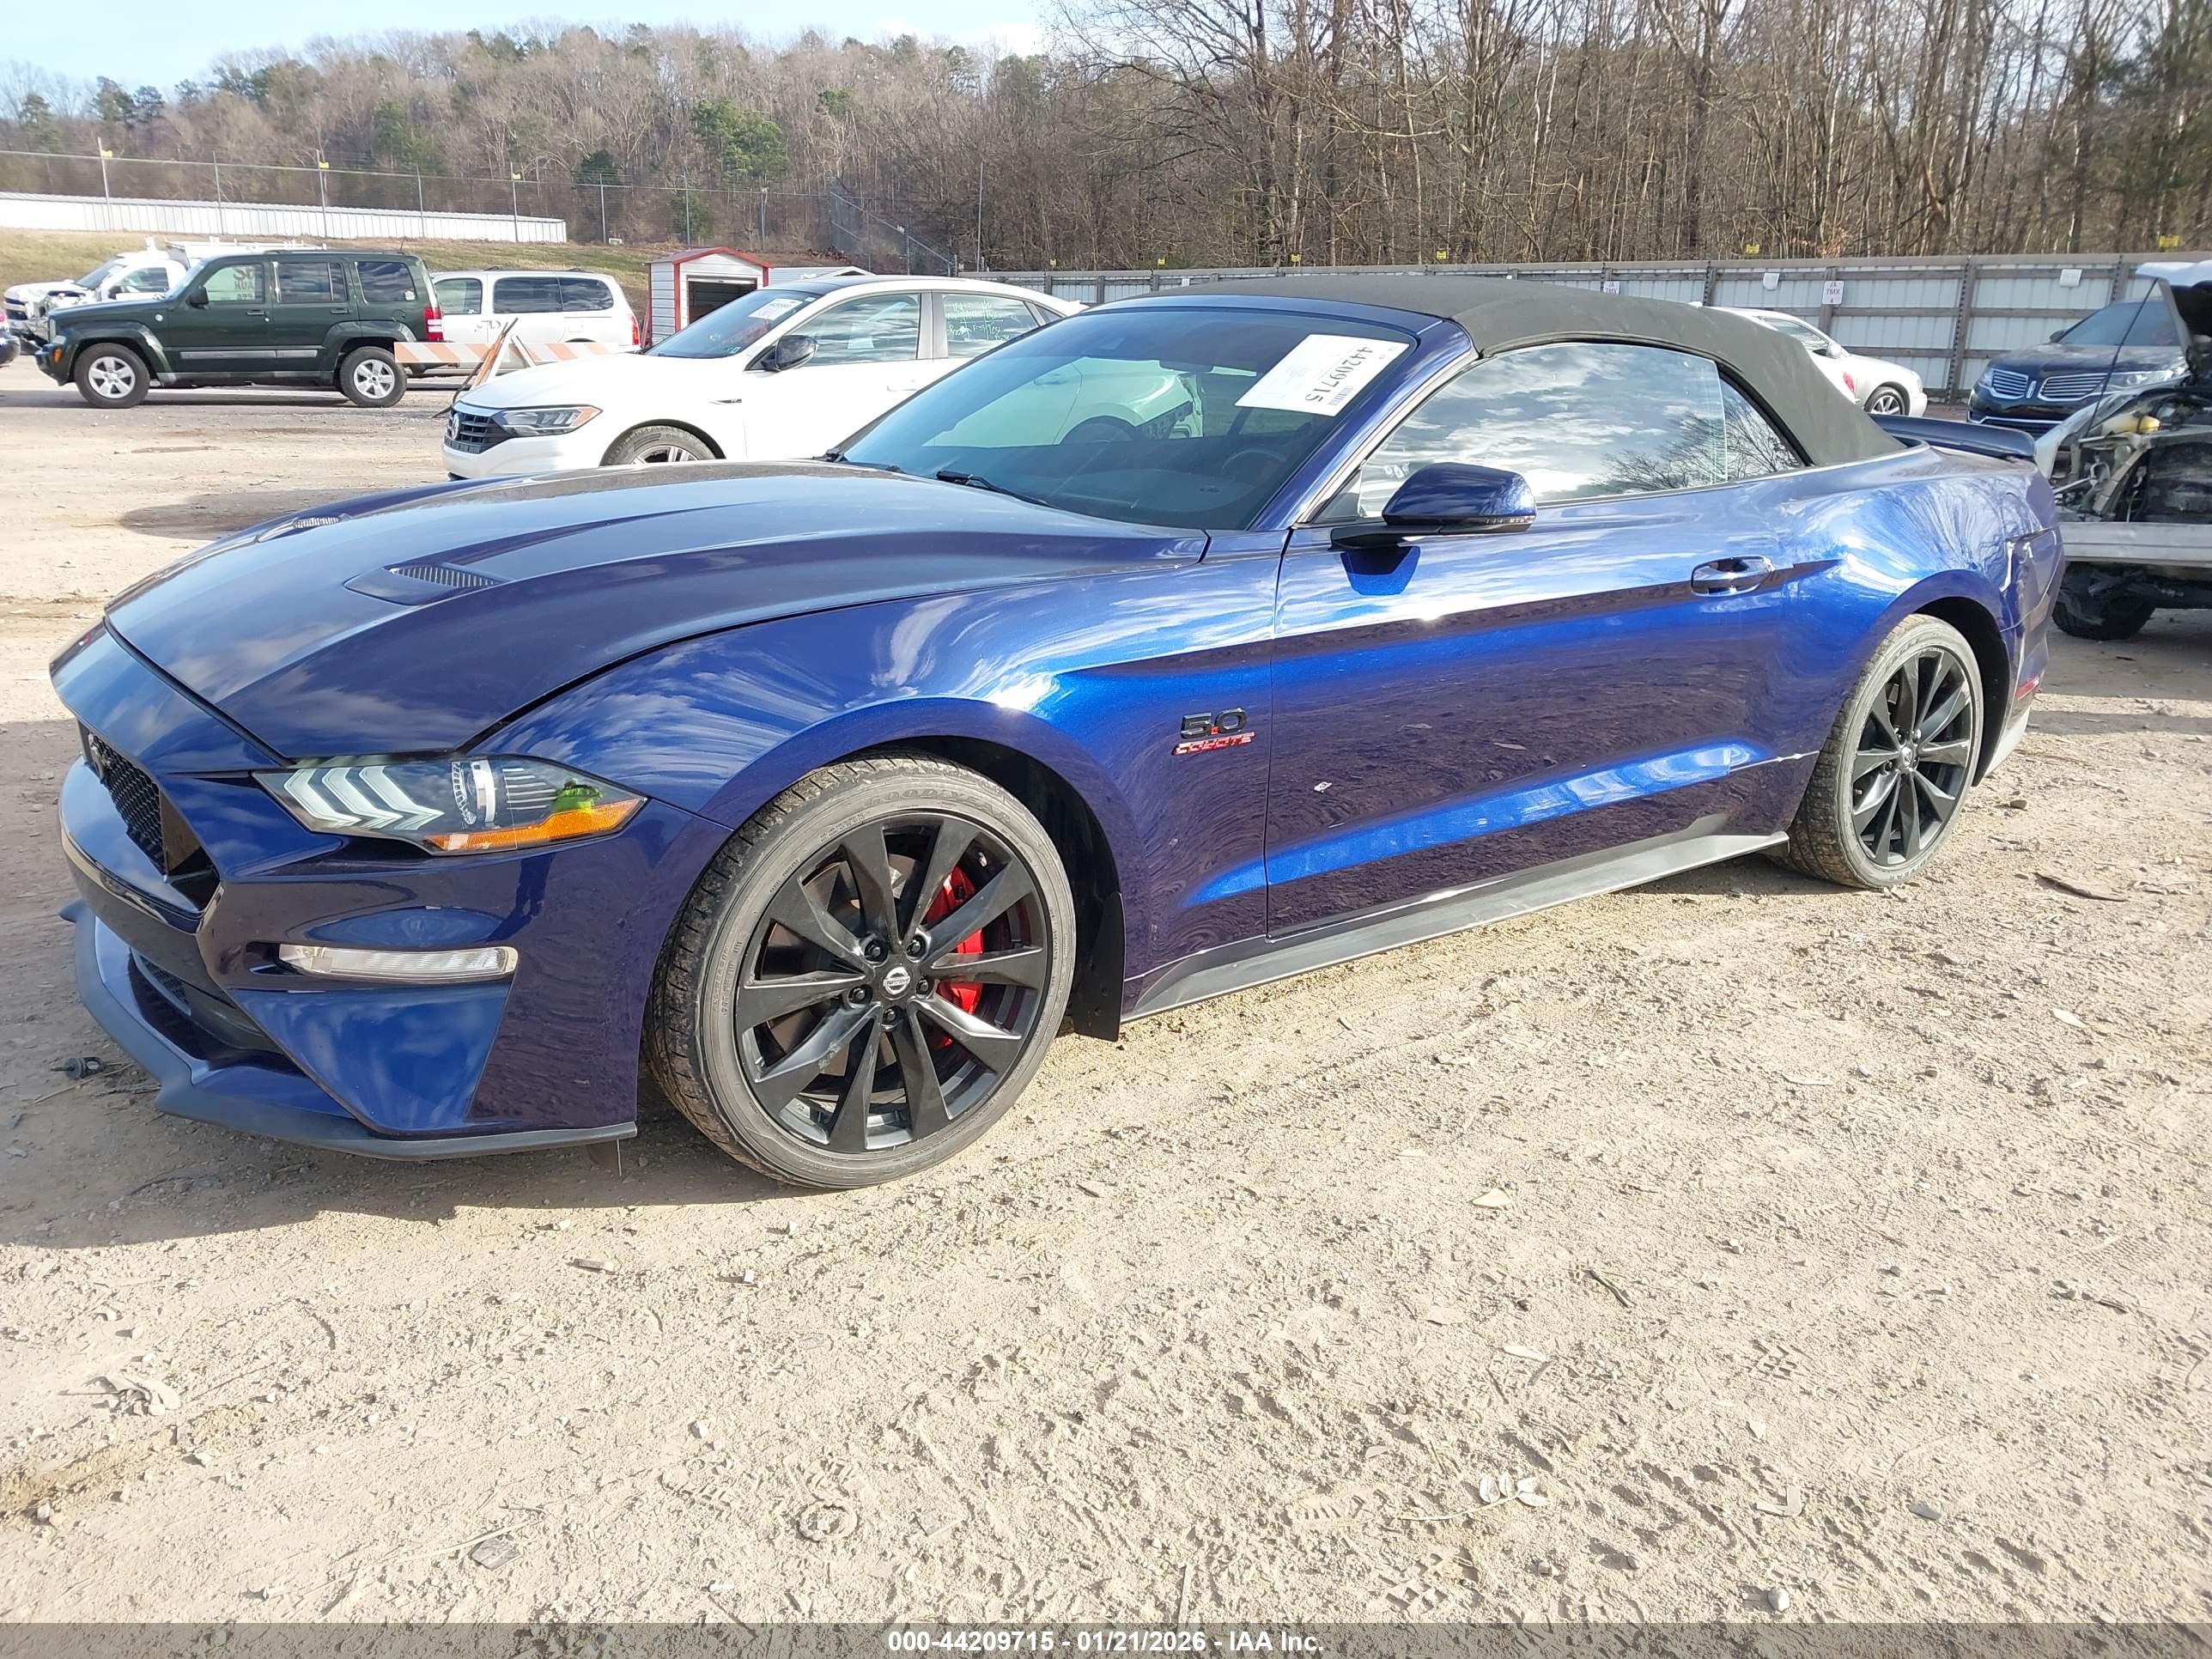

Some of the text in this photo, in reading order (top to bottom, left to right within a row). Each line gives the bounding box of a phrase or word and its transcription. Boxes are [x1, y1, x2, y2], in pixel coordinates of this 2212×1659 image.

[1305, 346, 1373, 402] 44209715
[1181, 708, 1247, 739] 5.0
[864, 788, 1012, 823] GOODYEAR
